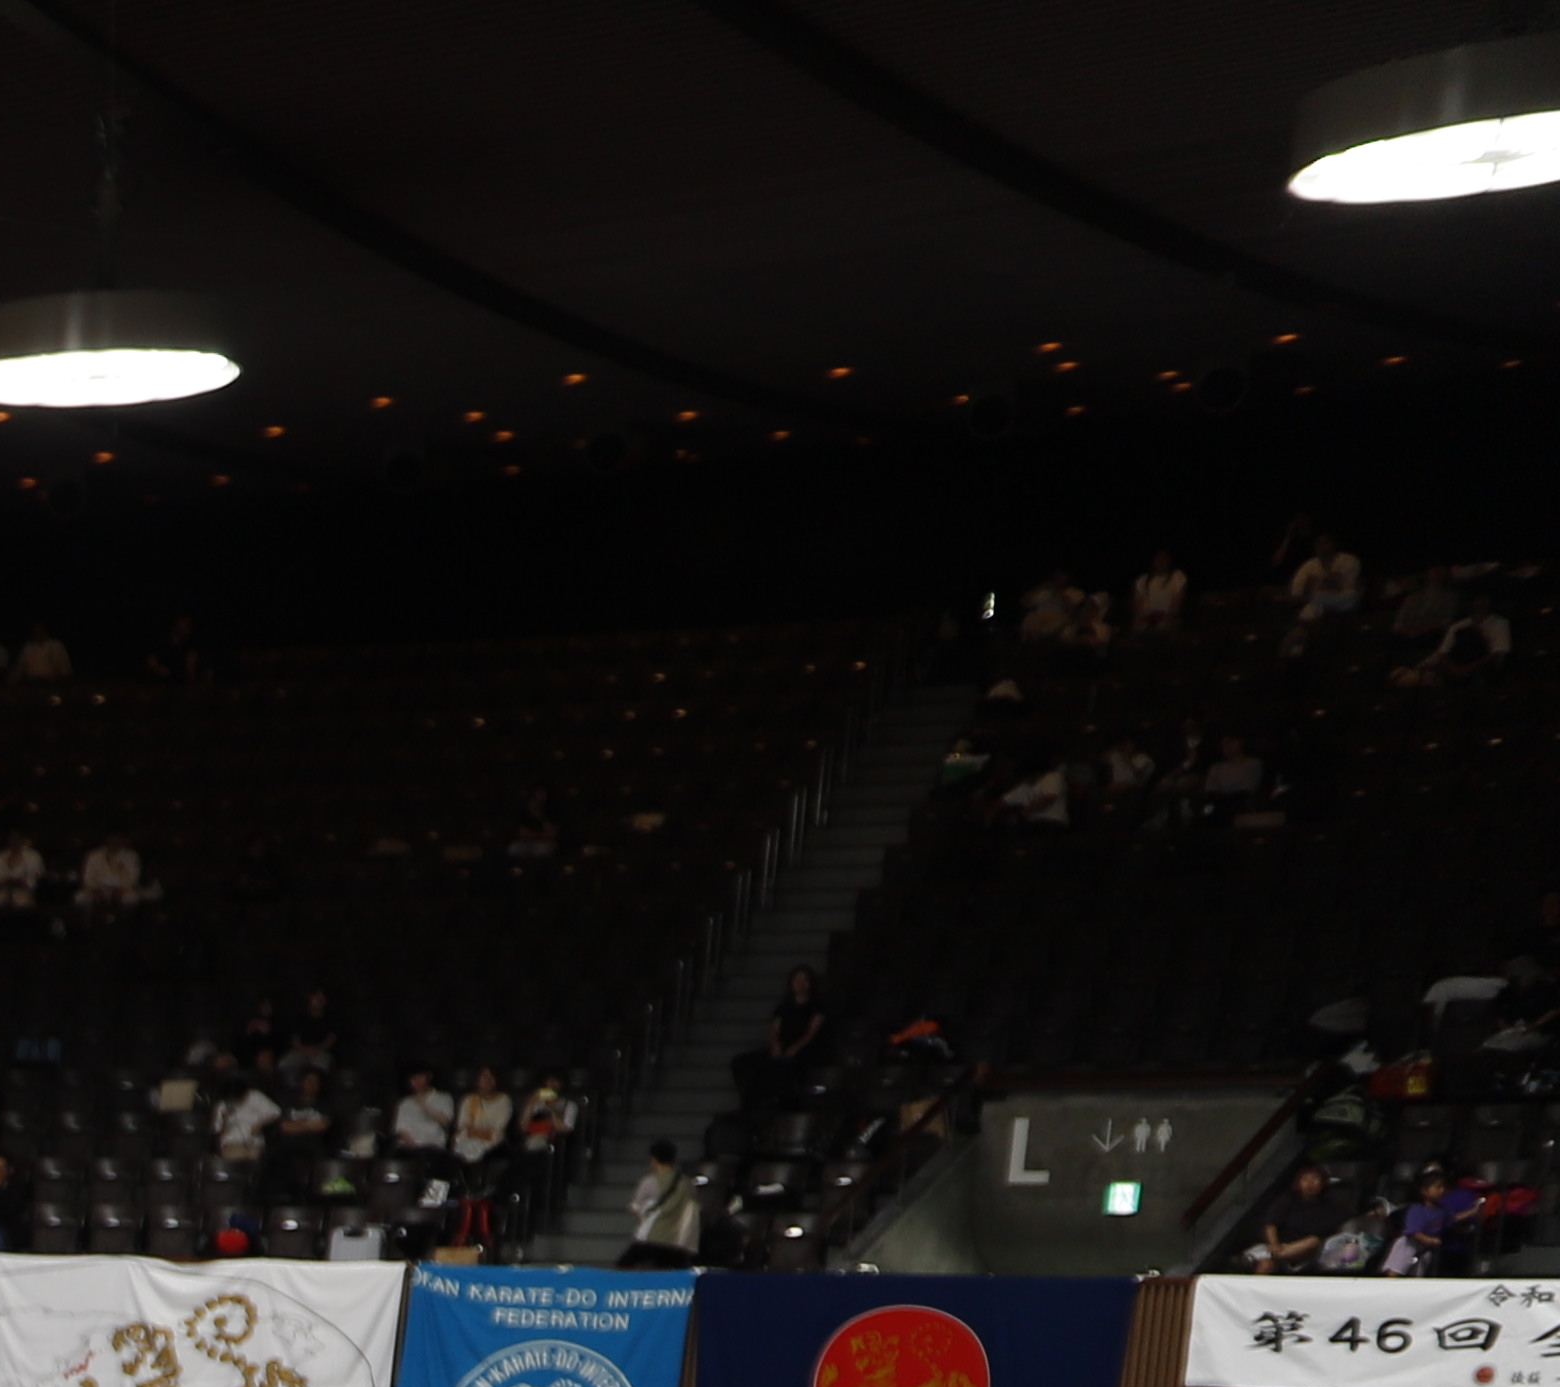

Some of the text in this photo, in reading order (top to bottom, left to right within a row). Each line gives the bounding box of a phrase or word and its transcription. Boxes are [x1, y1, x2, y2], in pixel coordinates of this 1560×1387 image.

[1008, 1117, 1050, 1184] L
[469, 1283, 597, 1309] KARATE-DO
[1486, 1283, 1557, 1308] 令和
[493, 1307, 631, 1331] FEDERATION
[1246, 1309, 1503, 1354] 第46回
